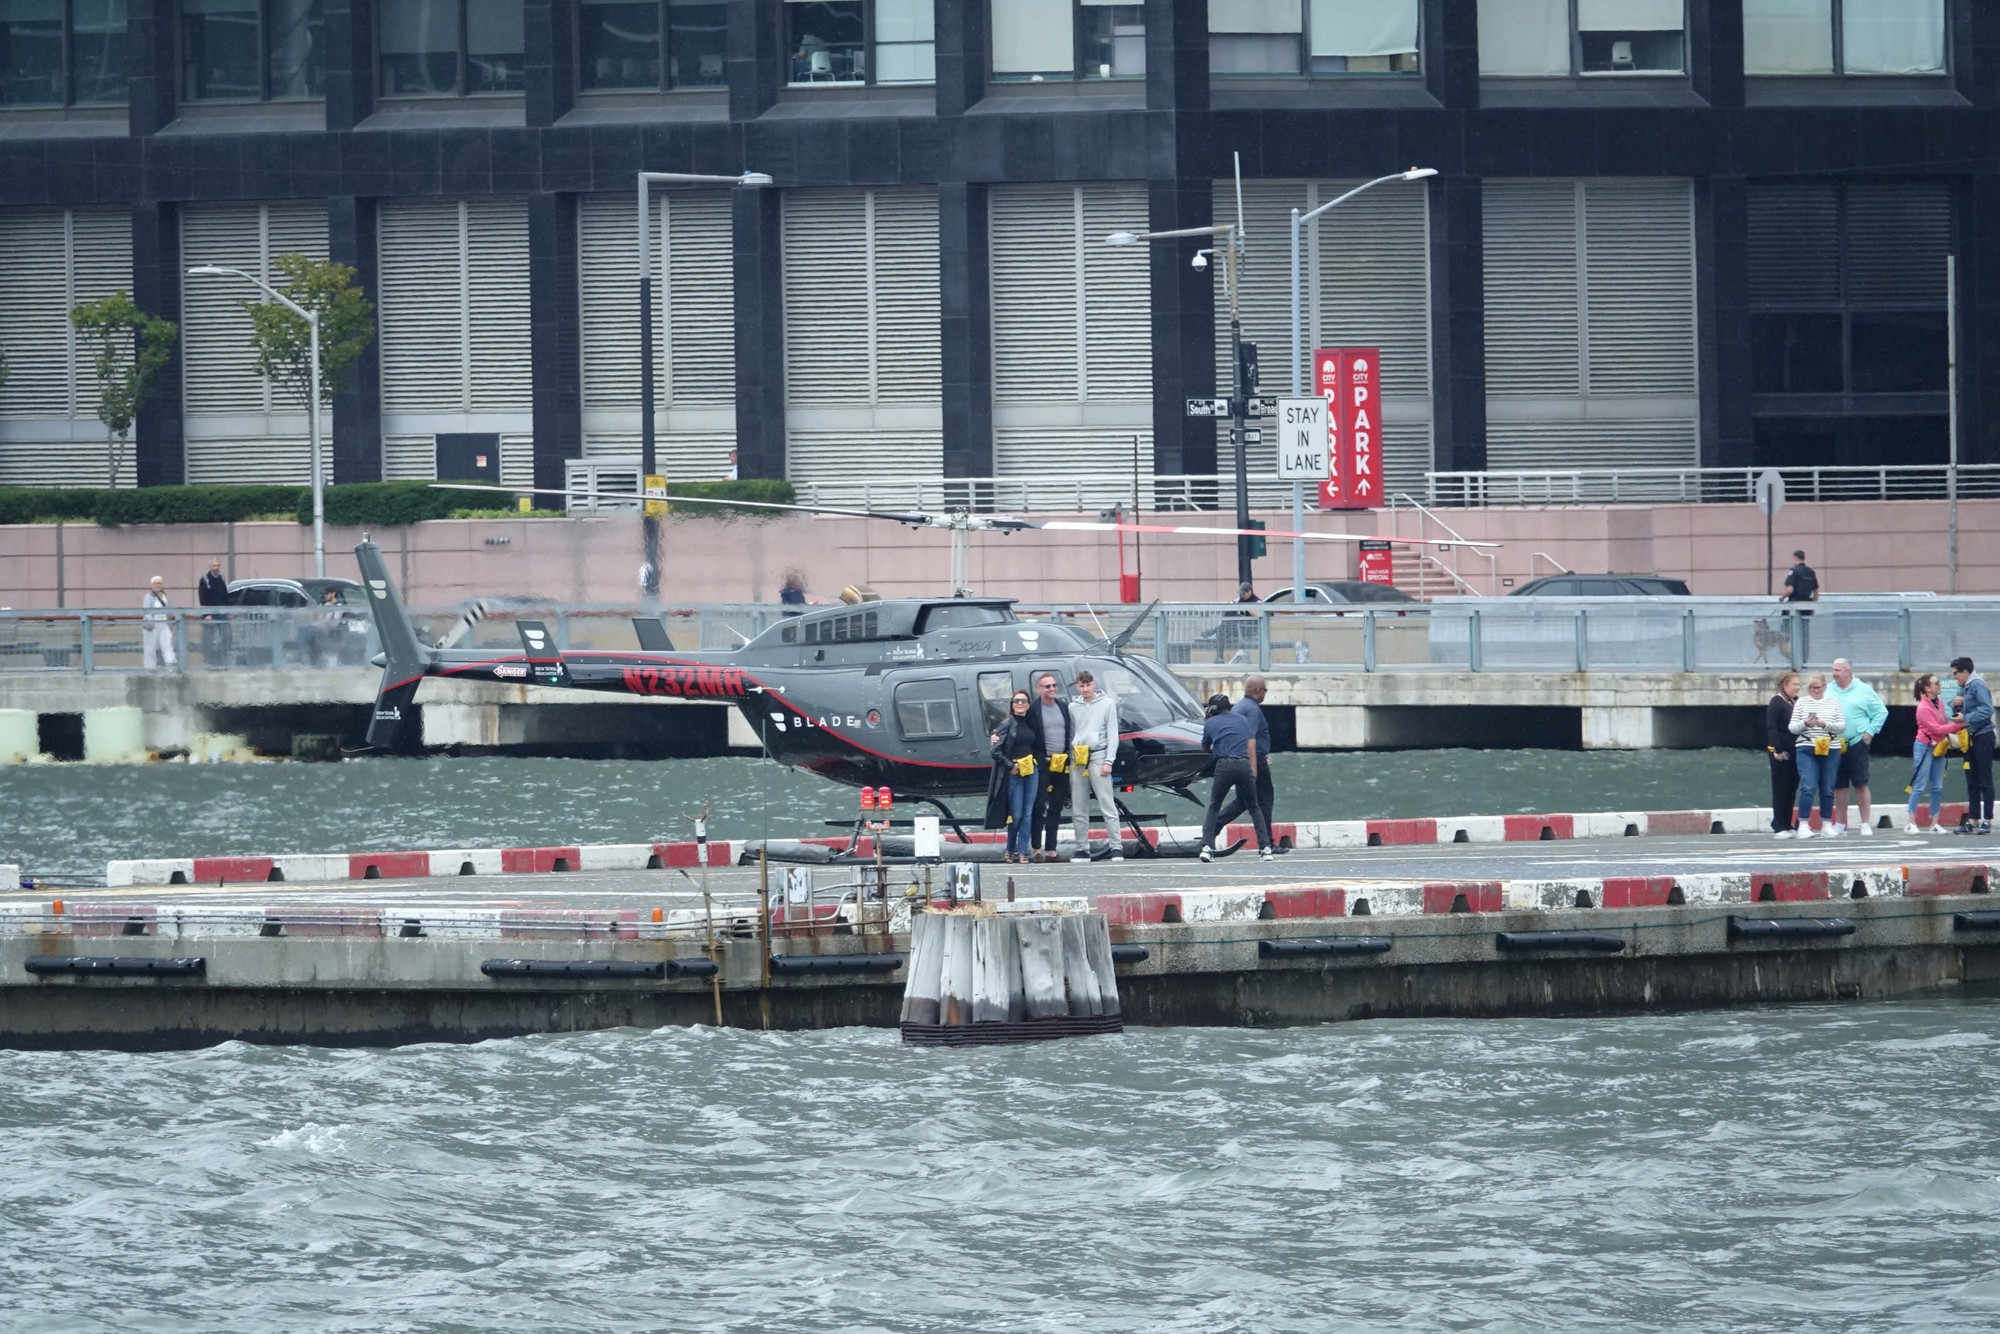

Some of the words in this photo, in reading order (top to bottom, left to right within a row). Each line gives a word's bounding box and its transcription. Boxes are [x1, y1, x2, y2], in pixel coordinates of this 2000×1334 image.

[1322, 374, 1336, 382] CITY
[1352, 373, 1368, 381] CITY
[1189, 404, 1211, 415] South
[1287, 407, 1319, 424] STAY
[1353, 386, 1371, 475] PARK
[1297, 430, 1309, 447] IN
[1286, 454, 1322, 471] LANE
[497, 668, 525, 676] DANGER
[622, 666, 746, 697] N232MH
[793, 715, 856, 728] BLADE
